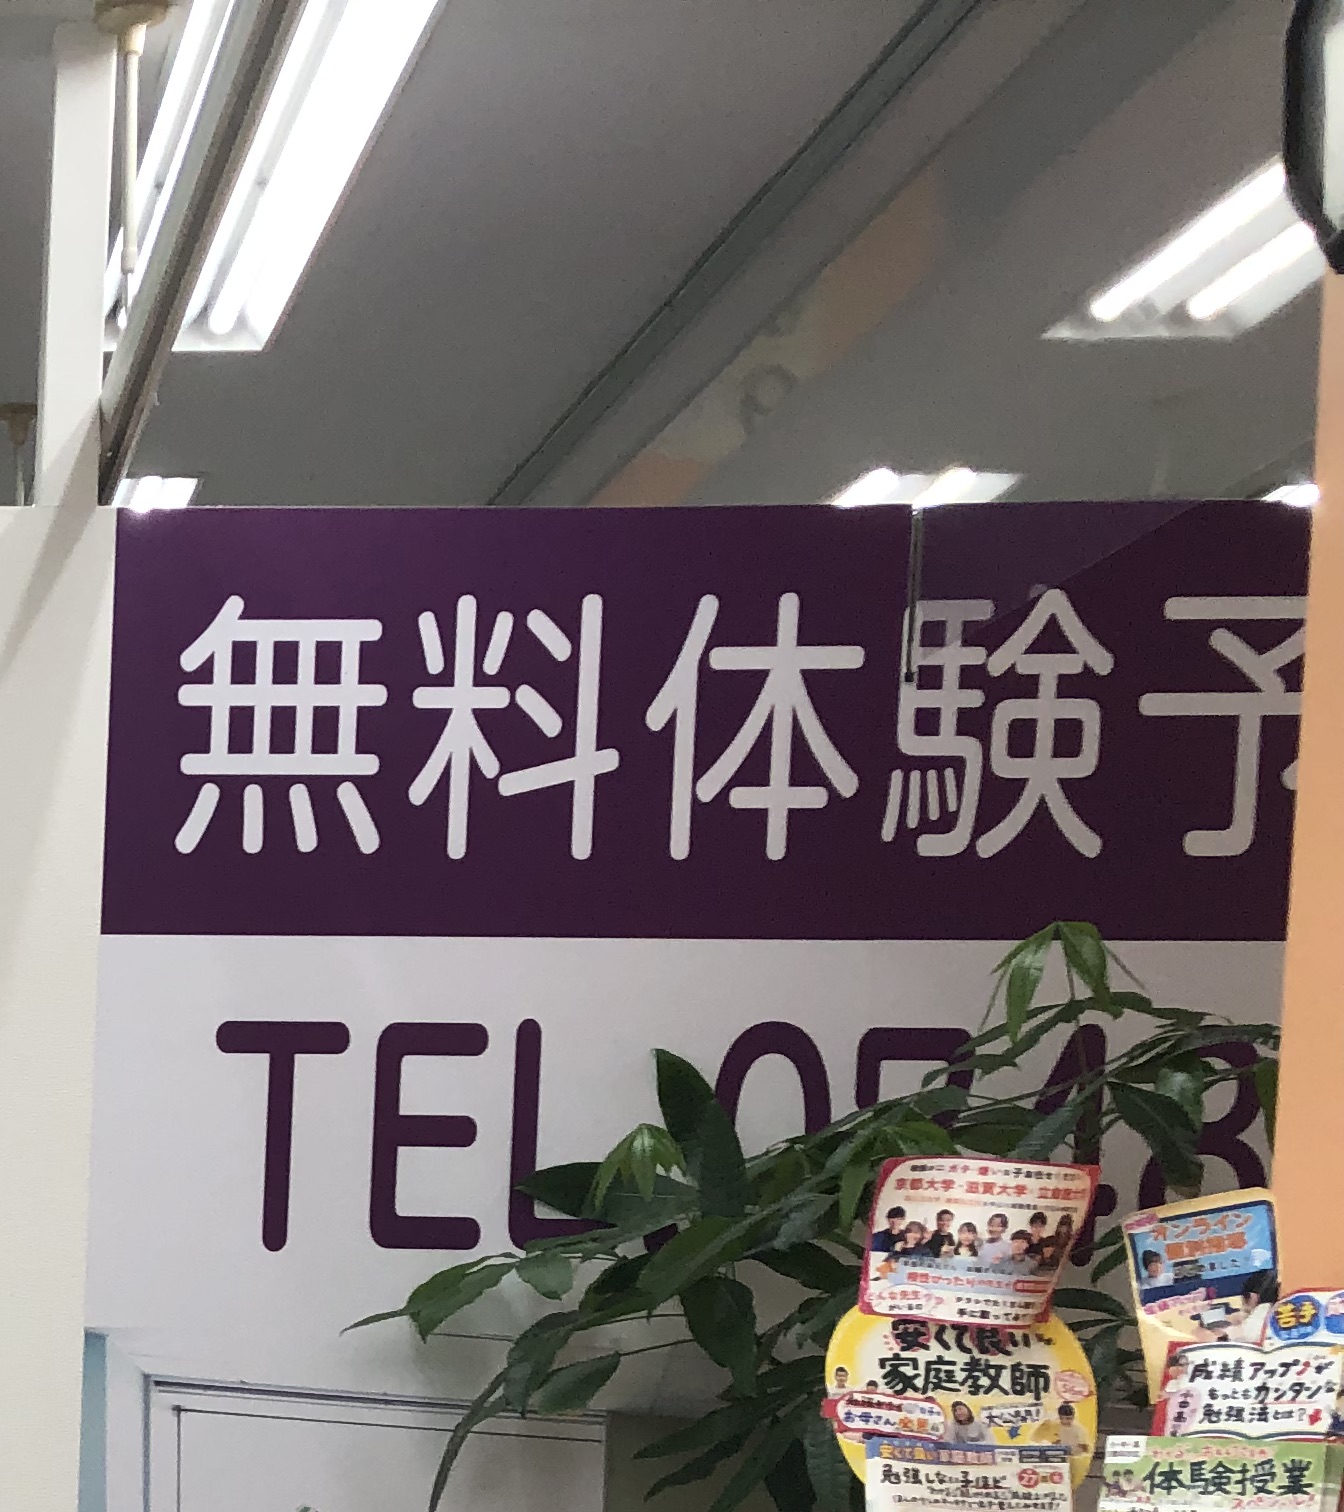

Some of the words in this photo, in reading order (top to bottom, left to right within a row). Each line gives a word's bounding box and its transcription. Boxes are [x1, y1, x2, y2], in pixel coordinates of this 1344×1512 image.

[878, 1353, 1052, 1401] 家庭教師
[1143, 1458, 1314, 1497] 体験授業
